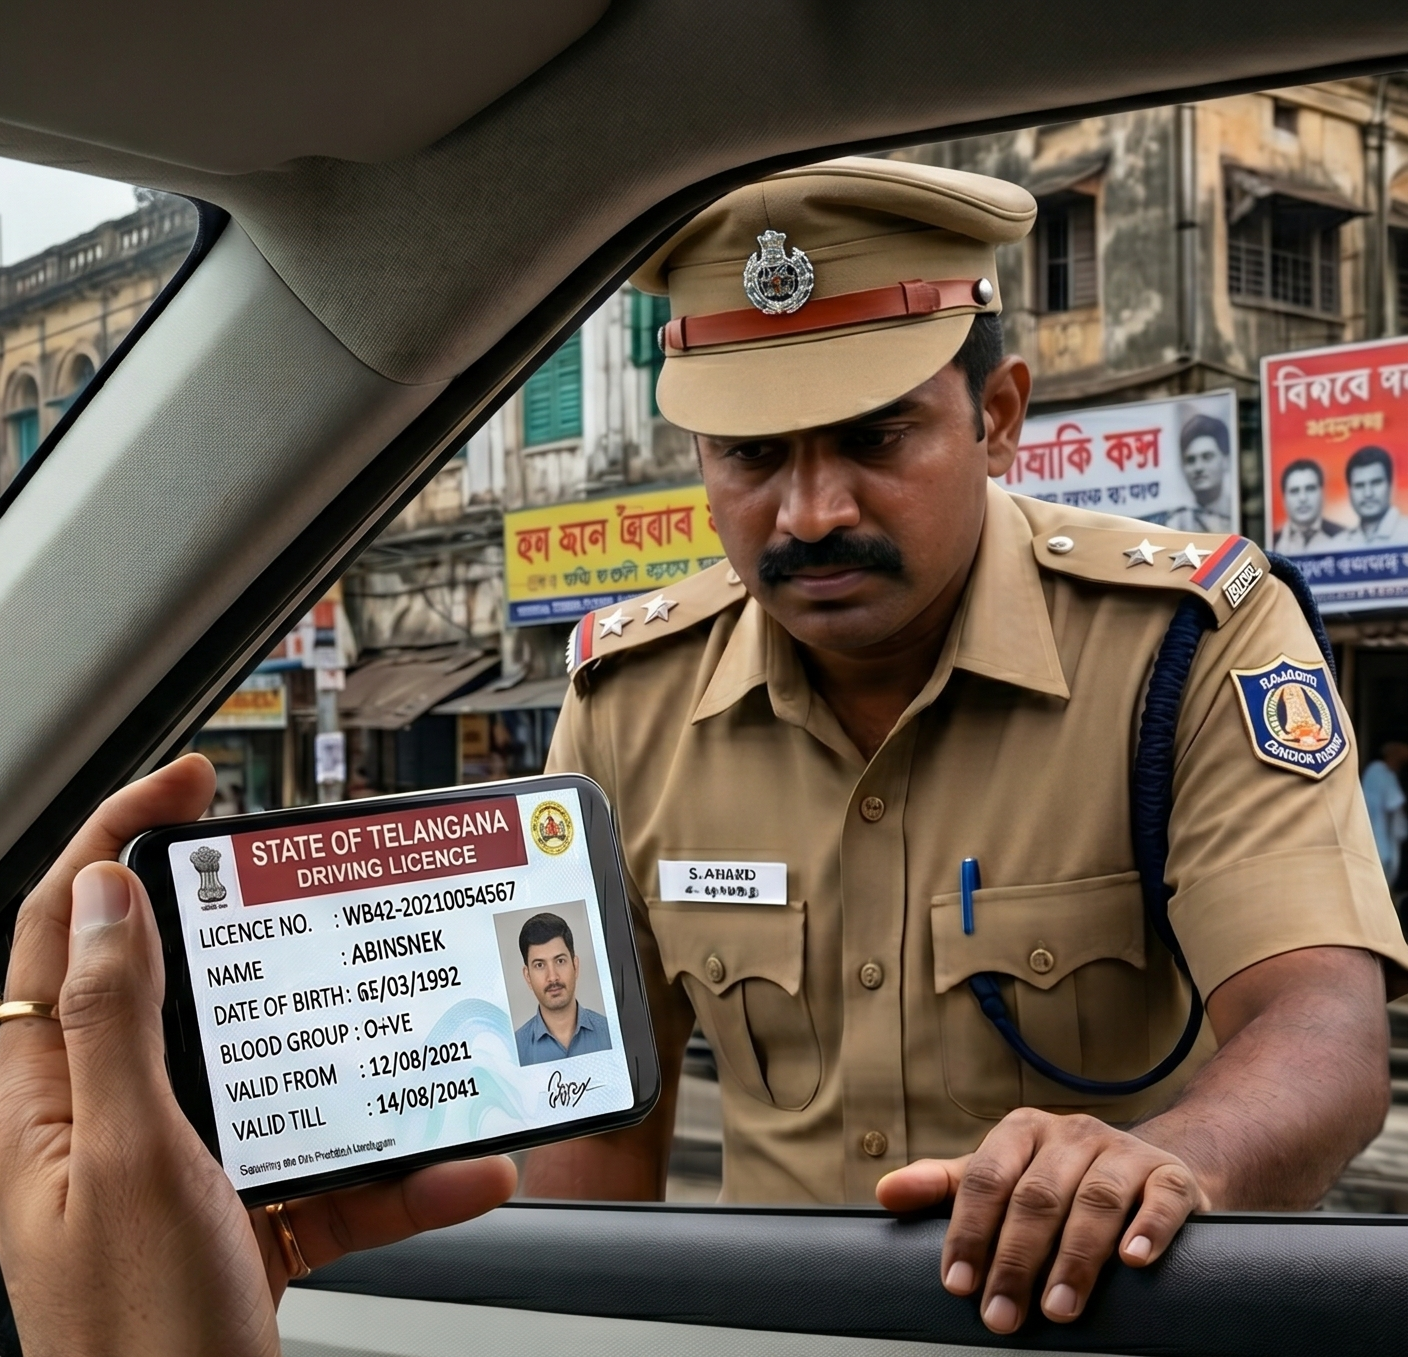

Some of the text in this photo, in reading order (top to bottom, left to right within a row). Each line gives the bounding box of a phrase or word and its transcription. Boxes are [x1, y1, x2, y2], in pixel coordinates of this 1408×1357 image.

[252, 809, 509, 866] STATE OF TELANGANA
[297, 844, 477, 888] DRIVING LICENCE
[199, 918, 275, 948] LICENCE
[279, 913, 313, 937] NO.
[342, 881, 516, 926] WB42-20210054567
[207, 960, 264, 988] NAME
[352, 929, 446, 965] ABINSNEK
[213, 1000, 260, 1026] DATE
[263, 994, 288, 1017] OF
[220, 1035, 282, 1065] BLOOD
[287, 1023, 349, 1052] GROUP
[364, 1012, 413, 1039] O+VE
[225, 1076, 279, 1103] VALID
[283, 1063, 338, 1093] FROM
[369, 1041, 472, 1078] 12/08/2021
[231, 1113, 286, 1142] VALID
[288, 1106, 327, 1131] TILL
[376, 1076, 479, 1115] 14/08/2041
